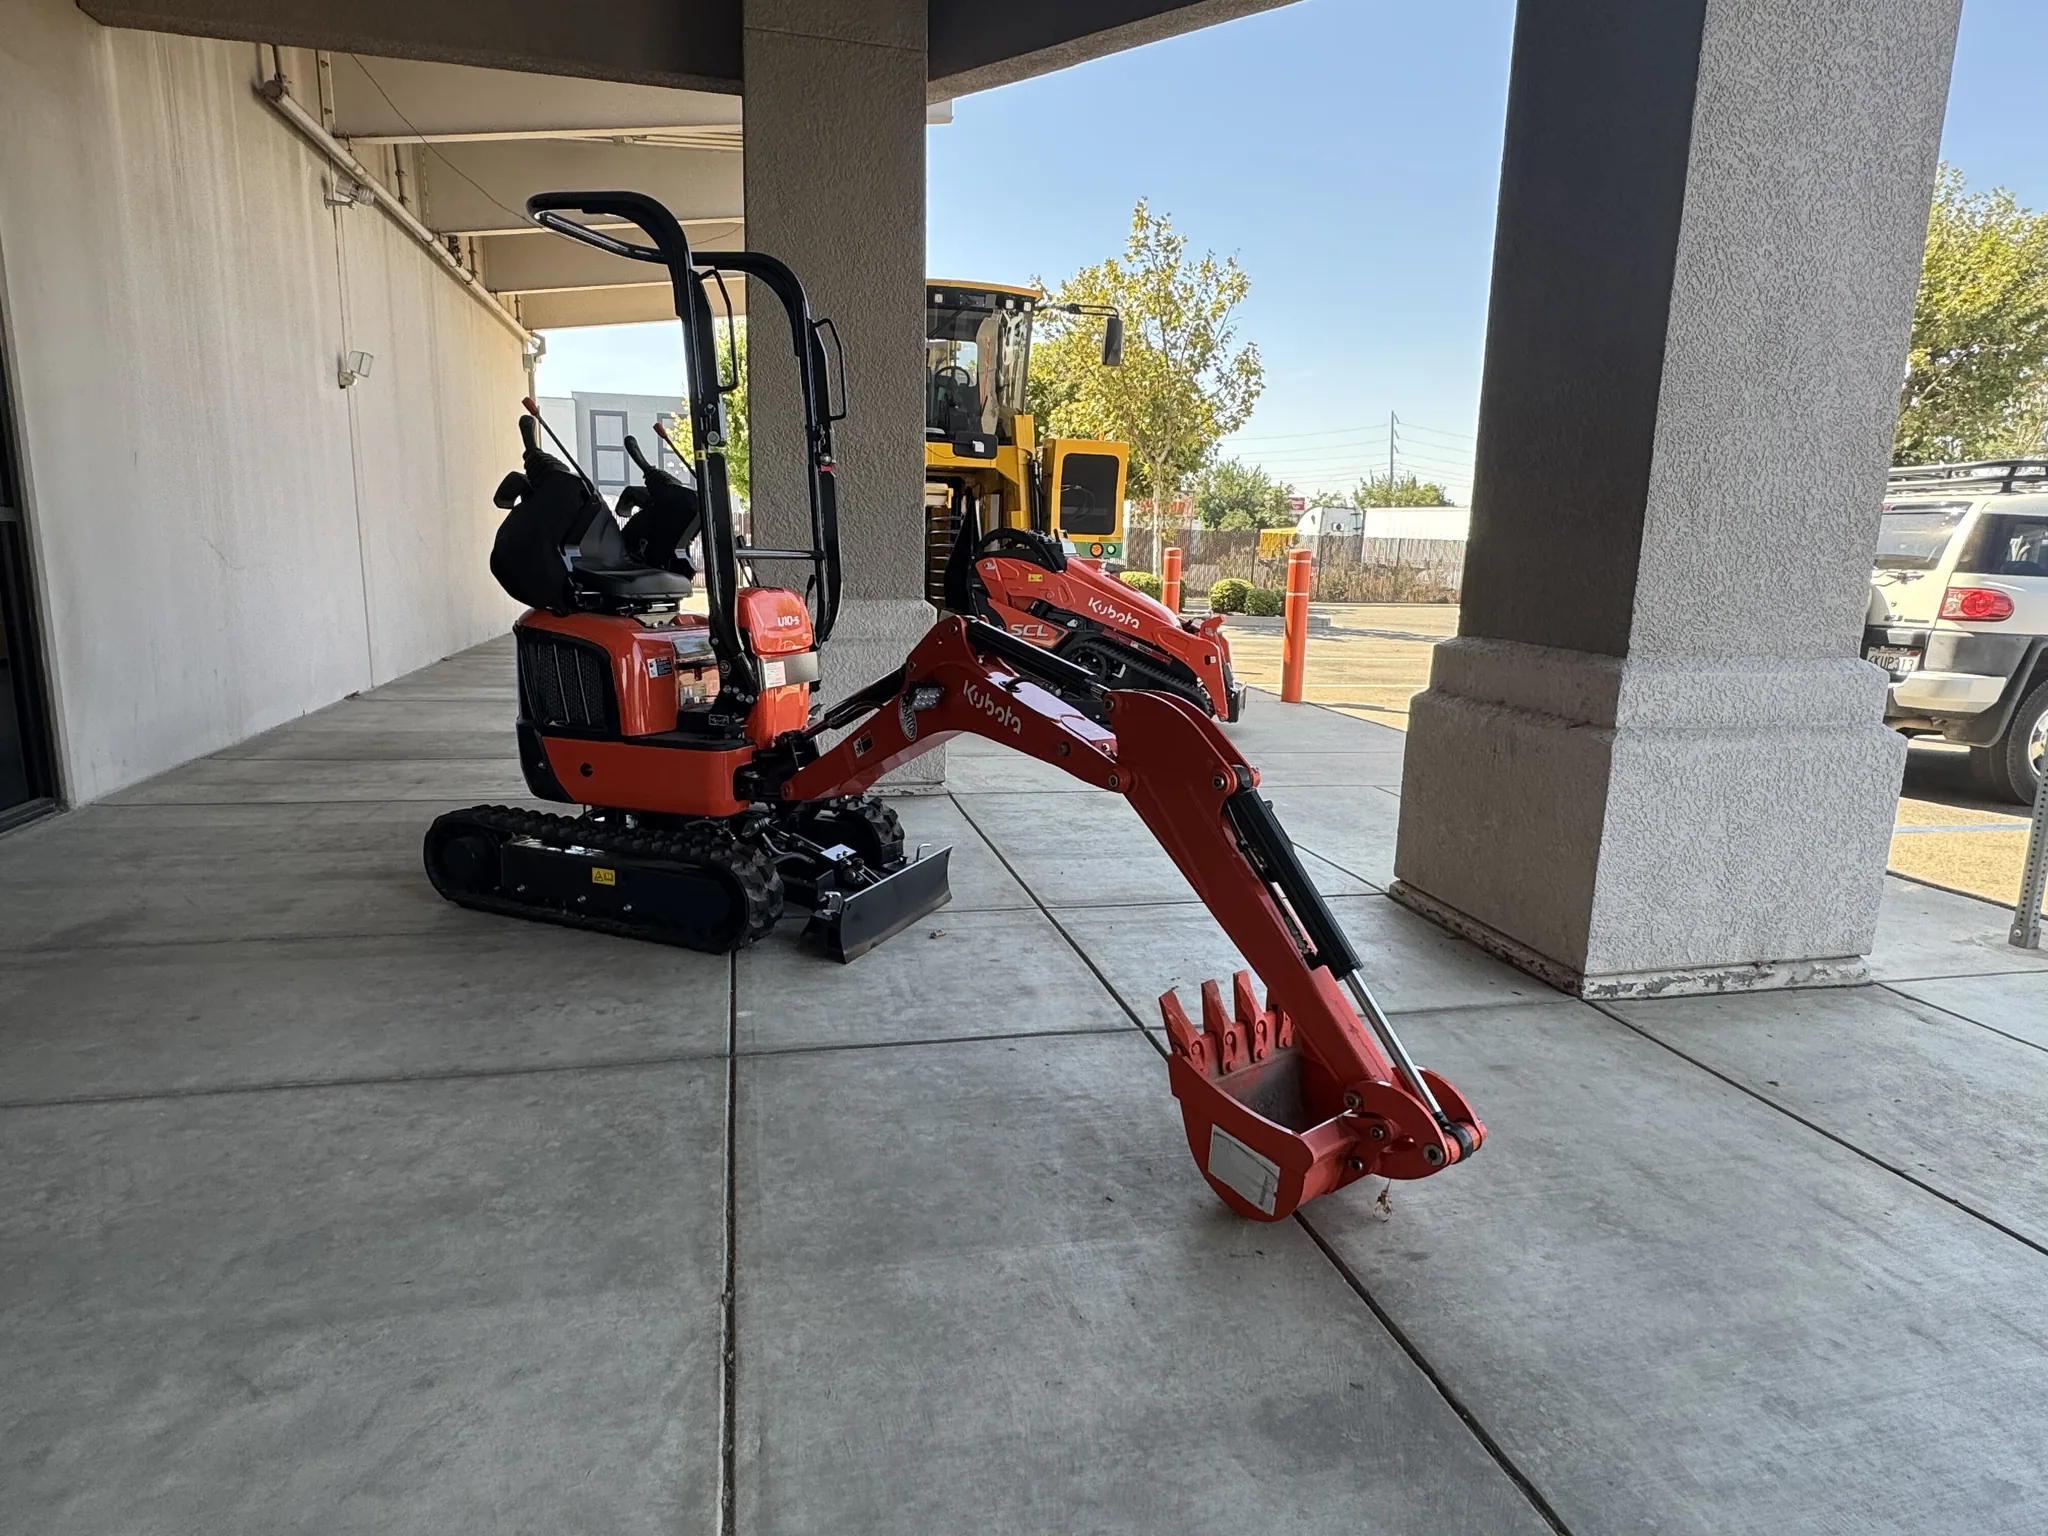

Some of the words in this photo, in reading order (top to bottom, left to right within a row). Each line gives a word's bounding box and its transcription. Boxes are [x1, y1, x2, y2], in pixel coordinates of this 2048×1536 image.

[1088, 597, 1140, 629] Kubota
[1010, 624, 1049, 638] SCL
[964, 680, 1021, 734] Kubota
